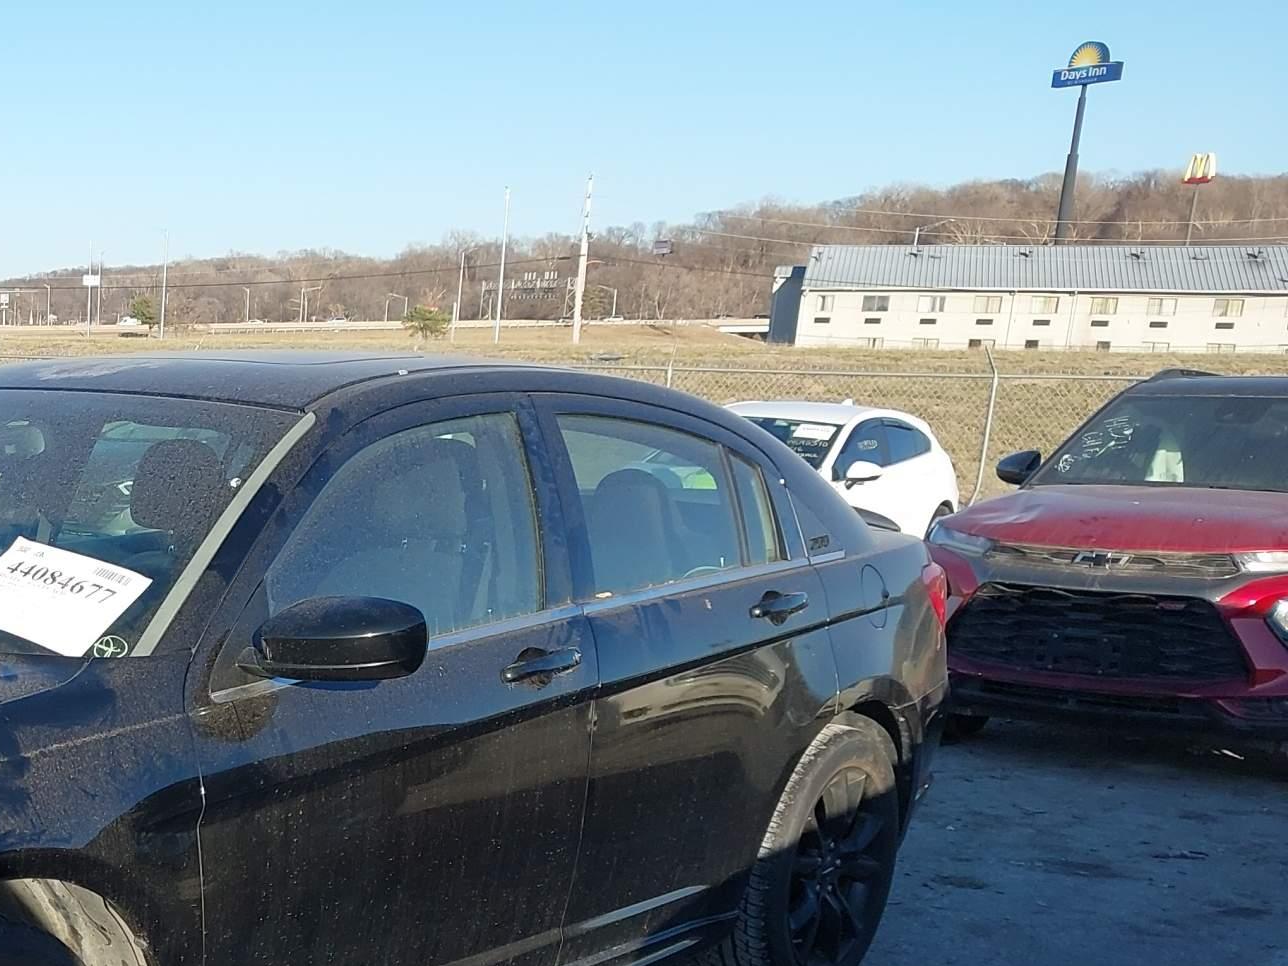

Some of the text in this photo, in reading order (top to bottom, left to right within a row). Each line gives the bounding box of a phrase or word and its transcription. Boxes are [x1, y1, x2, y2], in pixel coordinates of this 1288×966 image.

[1060, 67, 1087, 82] Days
[1088, 65, 1107, 77] Inn
[6, 560, 118, 604] 44084677
